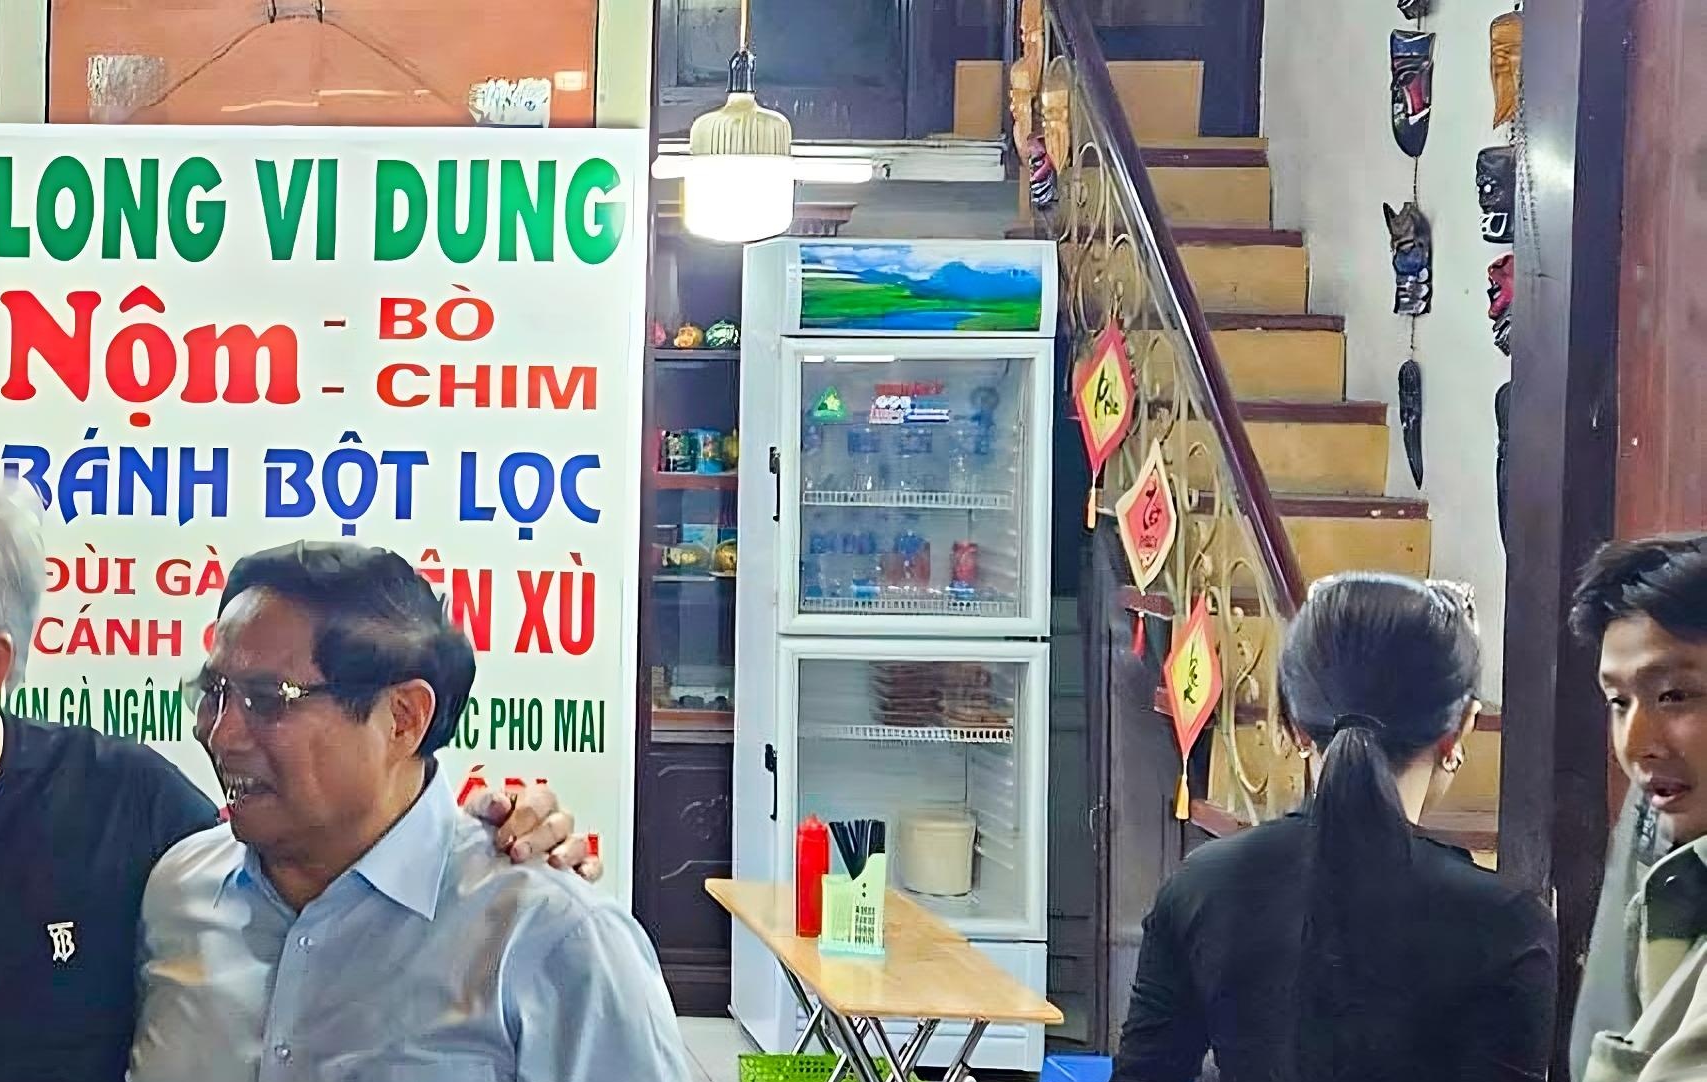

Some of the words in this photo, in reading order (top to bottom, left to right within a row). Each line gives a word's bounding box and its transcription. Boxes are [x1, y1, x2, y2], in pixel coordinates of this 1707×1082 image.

[255, 158, 339, 262] VI
[374, 157, 626, 264] DUNG
[378, 284, 494, 340] BÒ
[0, 285, 301, 427] Nộm
[376, 364, 597, 410] CHIM
[0, 427, 229, 526] BÁNH
[263, 431, 429, 537] BỘT
[459, 451, 602, 540] LỌC
[155, 545, 225, 596] GÀ
[33, 603, 182, 656] CÁNH
[514, 552, 596, 655] XÙ
[103, 677, 182, 742] NGÂM
[490, 698, 543, 751] PHO
[554, 699, 605, 753] MAI
